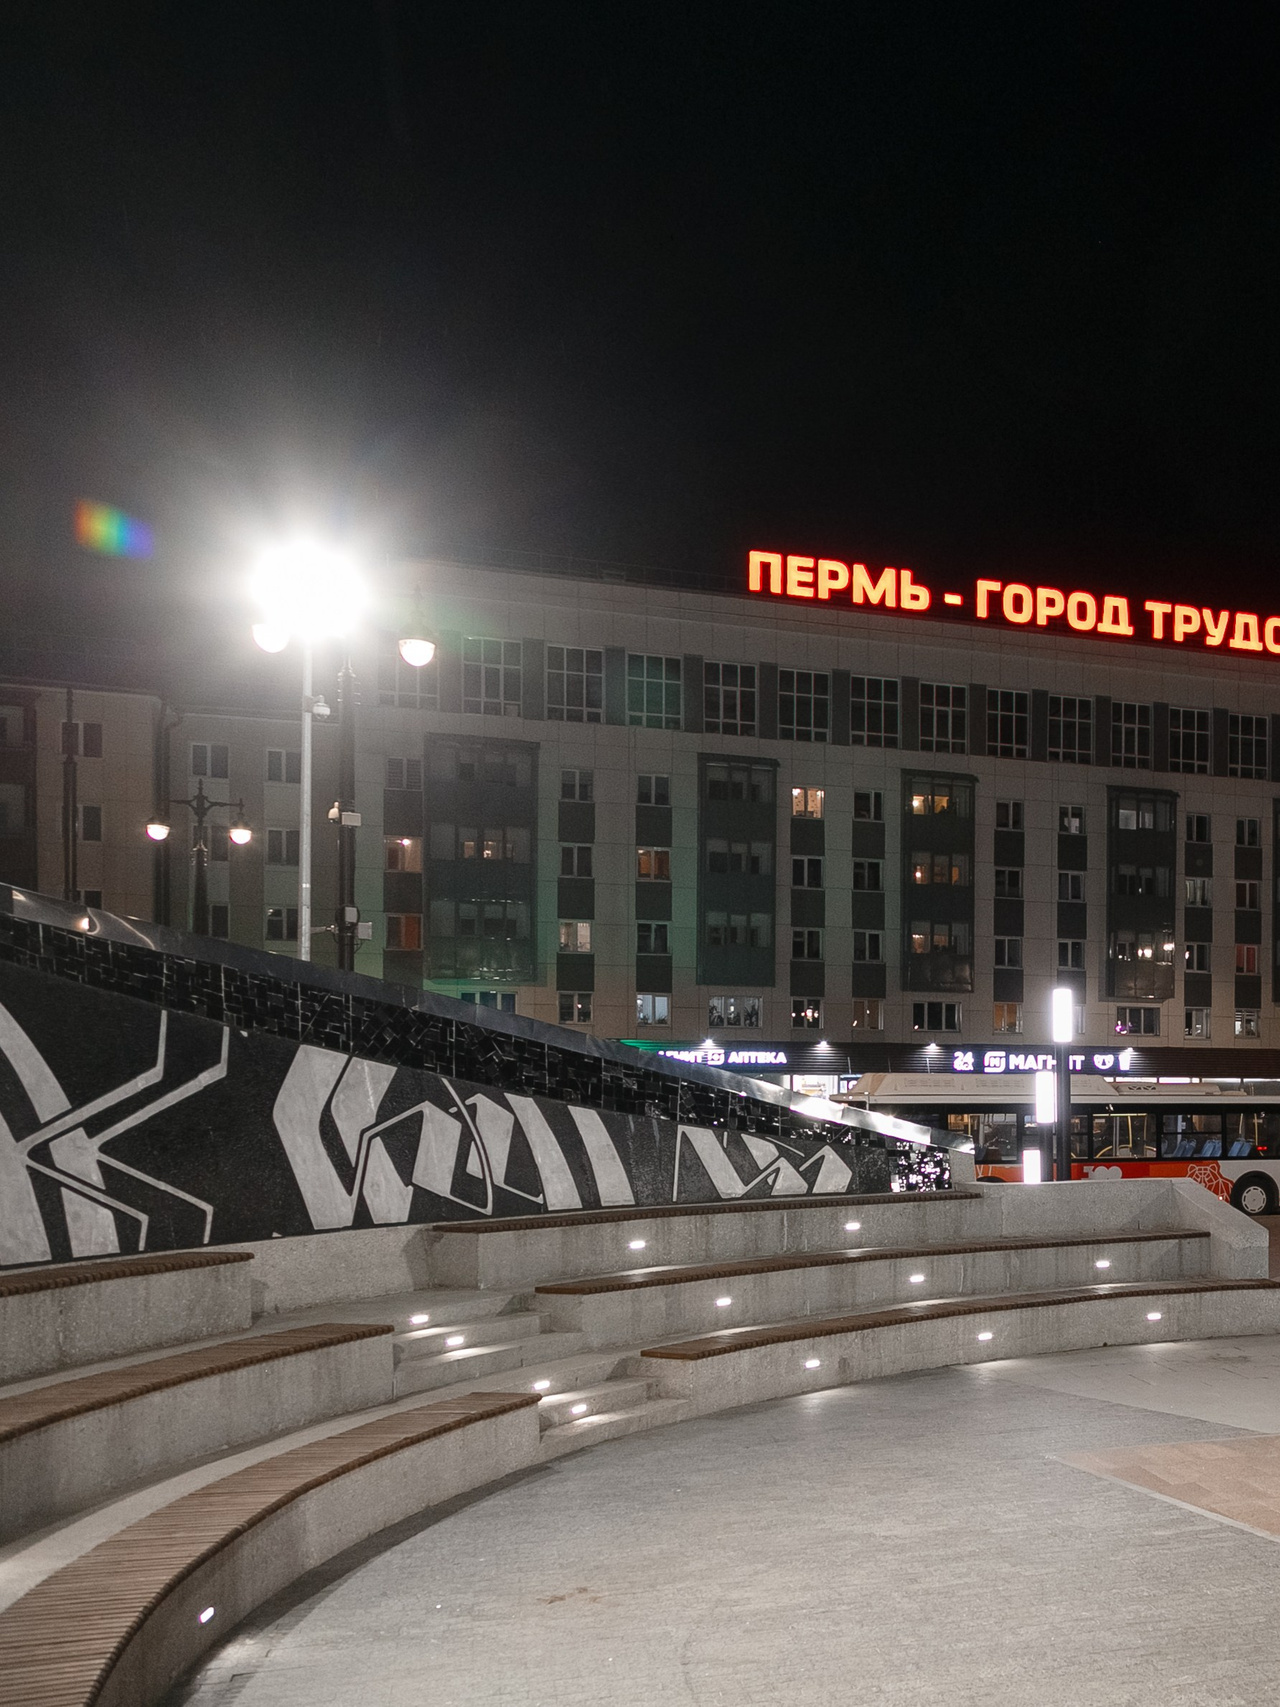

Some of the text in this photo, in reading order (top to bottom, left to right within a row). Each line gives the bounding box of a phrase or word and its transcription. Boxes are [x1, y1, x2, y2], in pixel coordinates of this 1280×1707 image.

[748, 550, 931, 611] ПЕРМЬ
[976, 579, 1134, 636] ГОРОД
[728, 1051, 787, 1064] АПТЕКА
